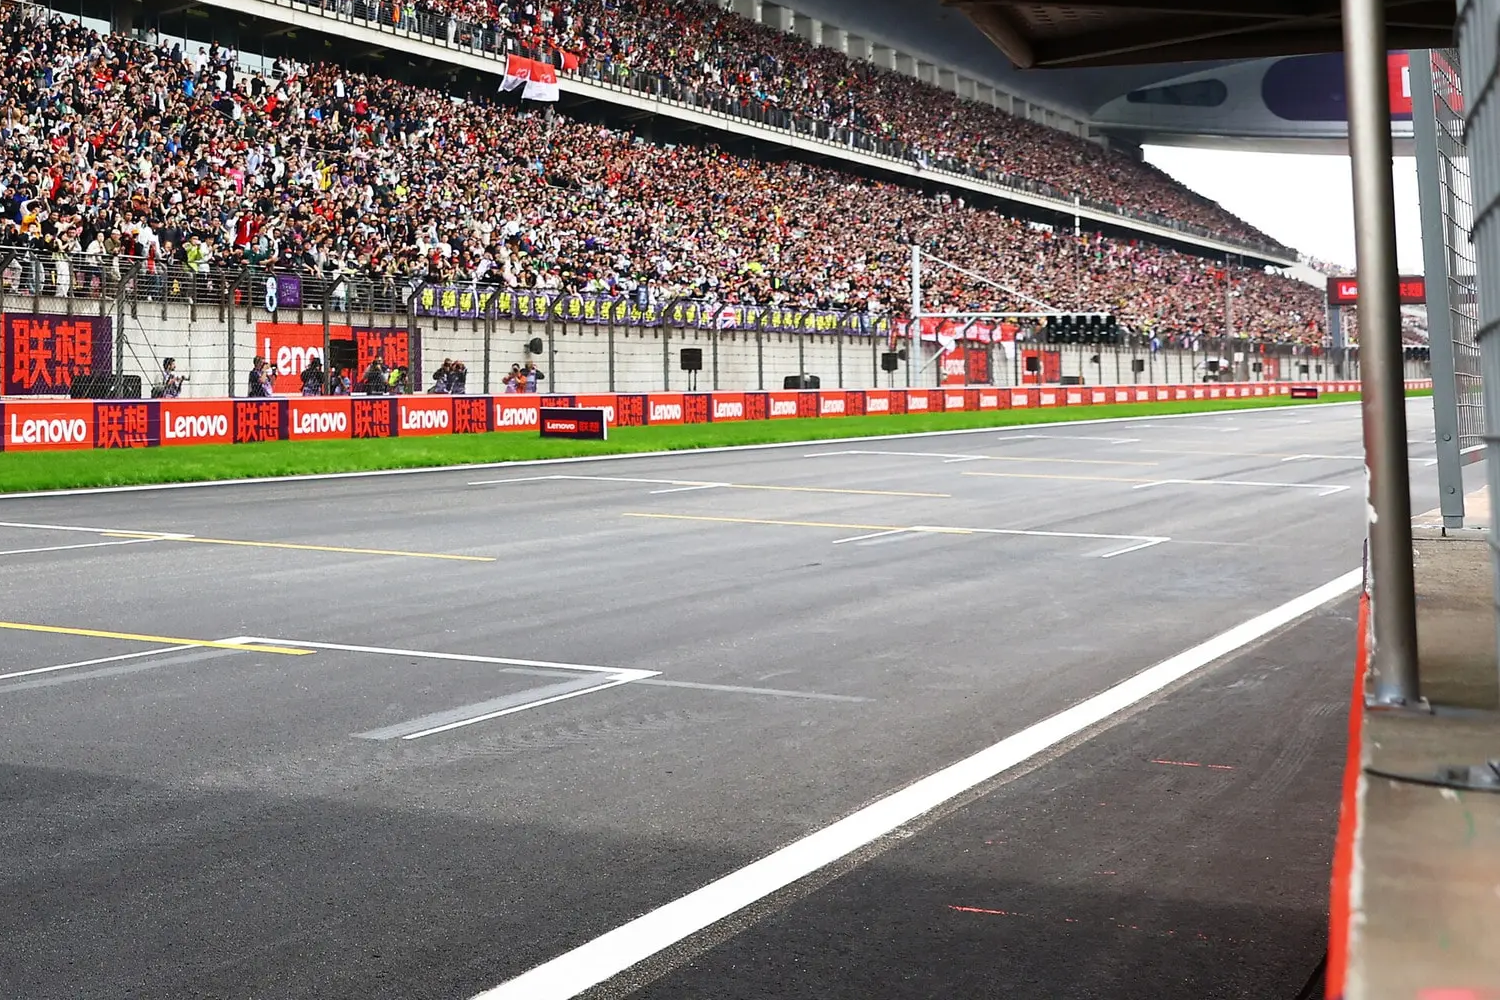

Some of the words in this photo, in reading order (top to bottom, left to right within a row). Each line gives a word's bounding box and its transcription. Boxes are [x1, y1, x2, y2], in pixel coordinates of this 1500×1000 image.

[12, 319, 92, 388] 联想
[355, 401, 390, 438] 联想
[402, 406, 448, 429] Lenovo
[454, 400, 486, 434] 联想
[497, 404, 537, 426] Lenovo
[618, 397, 642, 426] 联想
[650, 401, 681, 420] Lenovo
[714, 400, 743, 417] Lenovo
[770, 398, 796, 415] Lenovo
[11, 414, 86, 443] Lenovo
[98, 405, 148, 448] 联想
[165, 412, 227, 438] Lenovo
[237, 402, 278, 442] 联想
[293, 409, 347, 433] Lenovo
[547, 421, 575, 430] Lenovo
